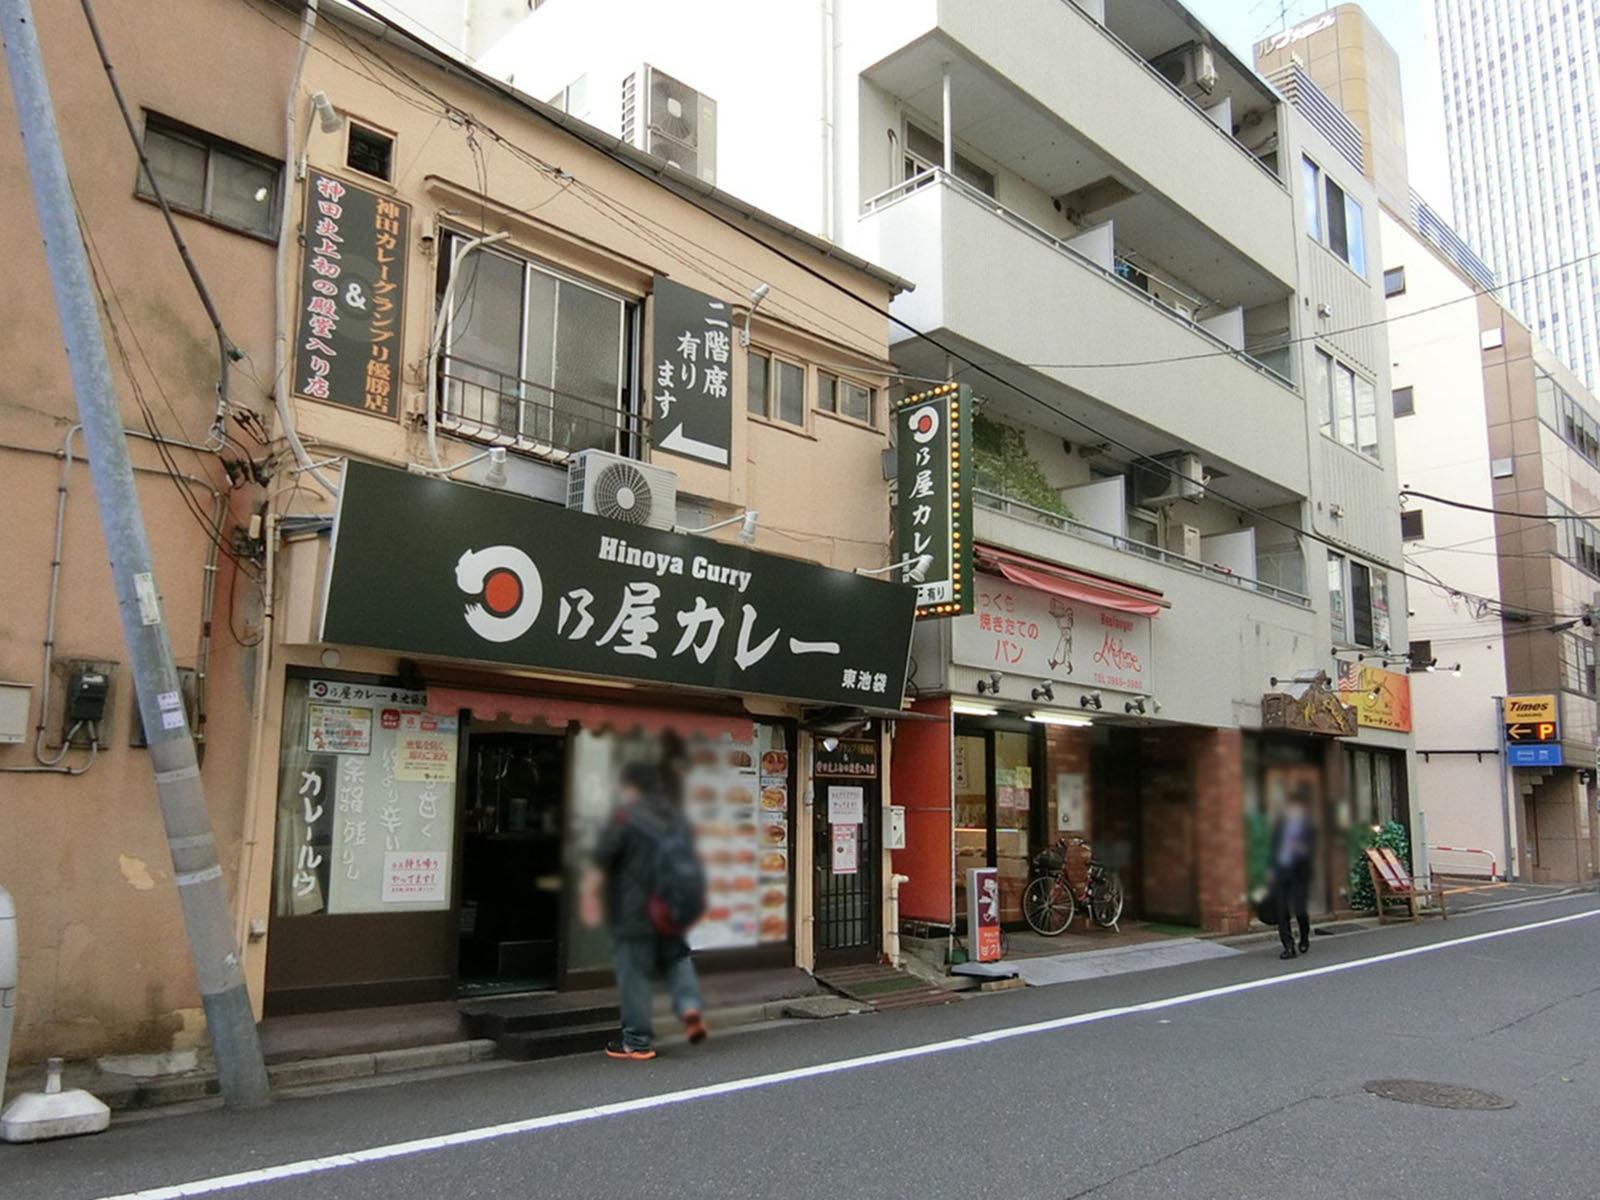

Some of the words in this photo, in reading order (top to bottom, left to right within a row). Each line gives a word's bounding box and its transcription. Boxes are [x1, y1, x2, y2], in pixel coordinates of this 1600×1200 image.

[303, 175, 346, 398] 神田史上初の殿堂入り店
[346, 283, 366, 310] &
[676, 330, 701, 390] 有り
[702, 302, 730, 398] 二階席
[654, 359, 677, 419] ます
[908, 446, 936, 554] 乃屋カレ
[598, 536, 684, 575] Hinoya
[691, 557, 752, 593] Curry
[558, 583, 841, 671] 乃屋カレー
[980, 612, 1039, 640] 焼きたての
[994, 639, 1024, 663] パン
[842, 668, 887, 694] 東池袋
[1510, 702, 1549, 712] Times
[1540, 724, 1553, 740] P
[292, 770, 323, 897] カレールウ
